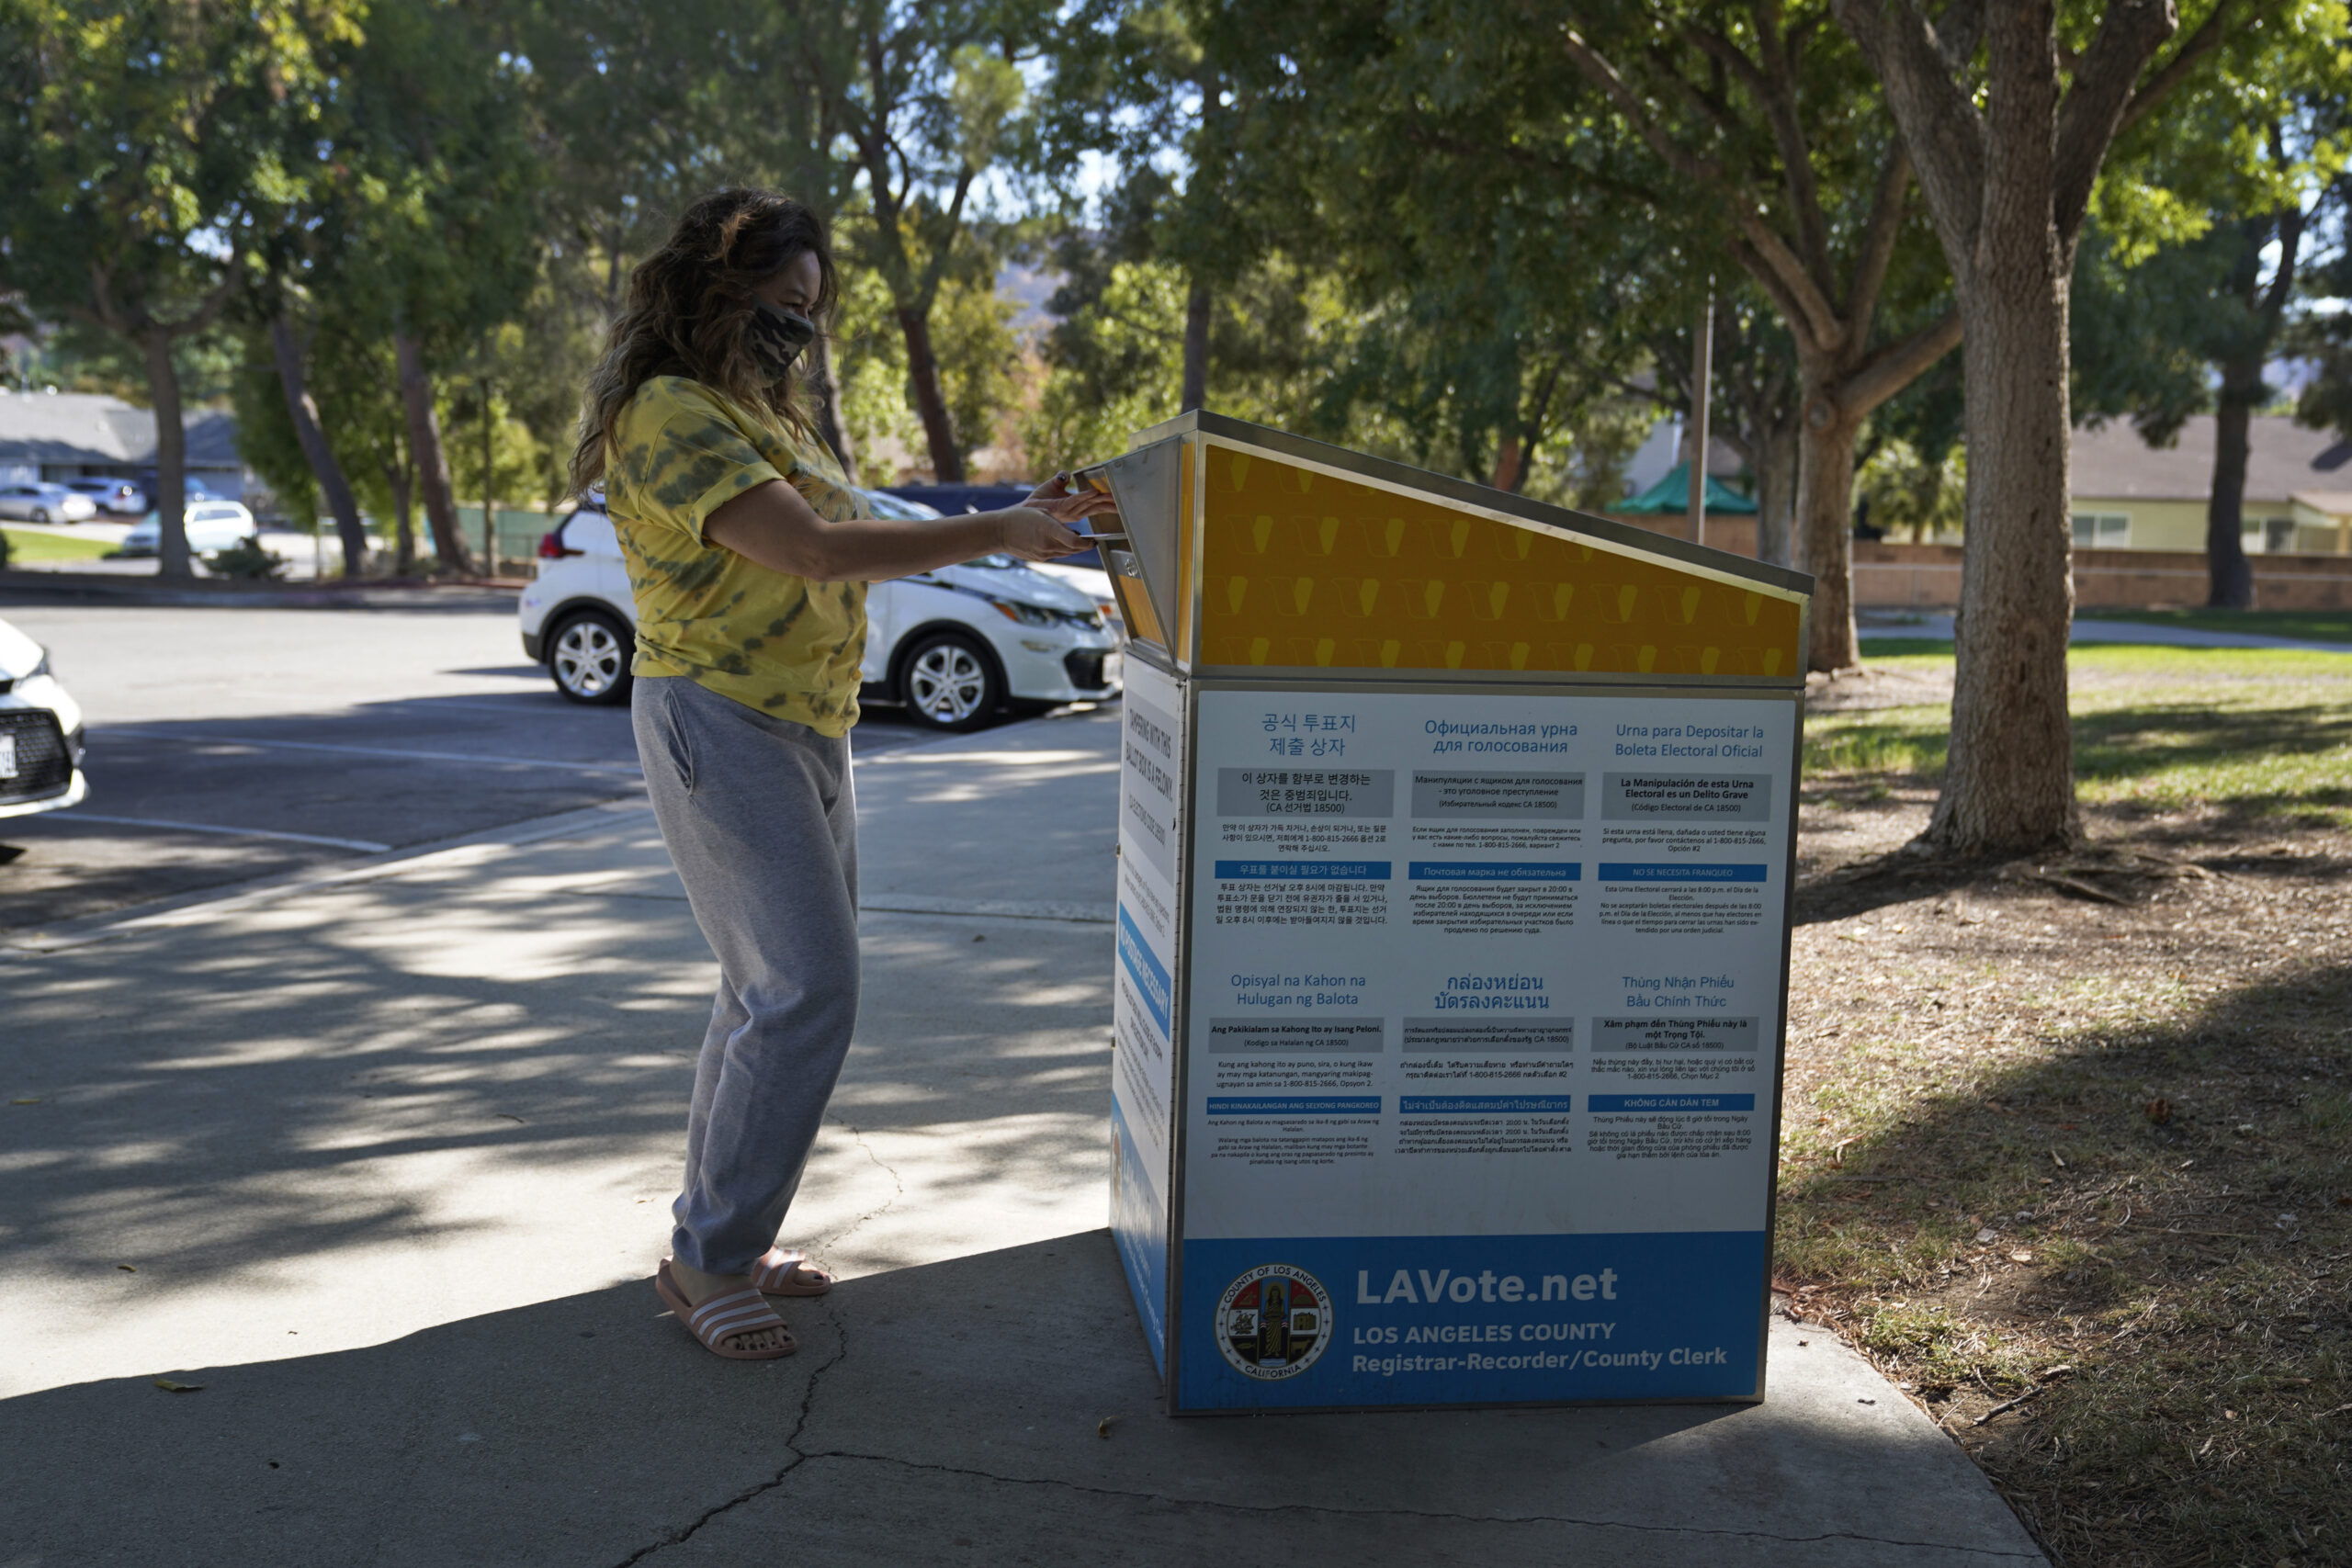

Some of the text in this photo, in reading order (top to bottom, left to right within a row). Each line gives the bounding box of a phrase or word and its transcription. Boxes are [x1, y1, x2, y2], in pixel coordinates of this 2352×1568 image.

[1262, 714, 1354, 733] 공식 투표지
[1425, 720, 1577, 738] Официальная урна
[1617, 724, 1763, 739] Urna para Depositar la
[1270, 738, 1345, 756] 제출 상자
[1433, 741, 1567, 754] для голосования
[1616, 743, 1762, 757] Boleta Electoral Oficial
[1242, 772, 1371, 785] 이 상자를 함부로 변경하는
[1415, 776, 1472, 785] Манипуляции
[1622, 779, 1633, 787] La
[1632, 779, 1695, 789] Manipulación
[1697, 779, 1709, 787] de
[1732, 780, 1754, 788] Urna
[1260, 789, 1351, 801] 것은 중범죄입니다.
[1625, 789, 1664, 797] Electoral
[1693, 790, 1720, 798] Delito
[1723, 790, 1748, 798] Grave
[1267, 803, 1344, 814] (CA 선거법 18500)
[1632, 804, 1659, 812] (Código
[1717, 805, 1741, 813] 18500)
[1714, 837, 1766, 845] 1-800-815-2666,
[1240, 865, 1267, 874] 우표를
[1301, 865, 1328, 874] 필요가
[1330, 865, 1366, 875] 없습니다
[1424, 867, 1465, 875] Почтовая
[1510, 868, 1566, 876] обязательна
[1231, 974, 1365, 988] Opisyal na Kahon na
[1448, 974, 1543, 989] กล่องหย่อน
[1623, 975, 1734, 990] Thùng Nhận Phiếu
[1238, 992, 1358, 1007] Hulugan ng Balota
[1435, 992, 1549, 1009] บัตรลงคะแนน
[1627, 994, 1726, 1007] Bầu Chính Thức
[1212, 1026, 1227, 1034] Ang
[1282, 1026, 1310, 1034] Kahong
[1335, 1026, 1354, 1034] Isang
[1664, 1031, 1688, 1040] Trọng
[1624, 1099, 1657, 1107] KHÔNG
[1224, 1266, 1327, 1303] COUNTY OF LOS ANGELES
[1357, 1268, 1617, 1303] LAVote.net
[1354, 1323, 1616, 1344] LOS ANGELES COUNTY
[1353, 1347, 1727, 1376] Registrar-Recorder/County Clerk
[1245, 1364, 1301, 1378] CALIFORNIA
